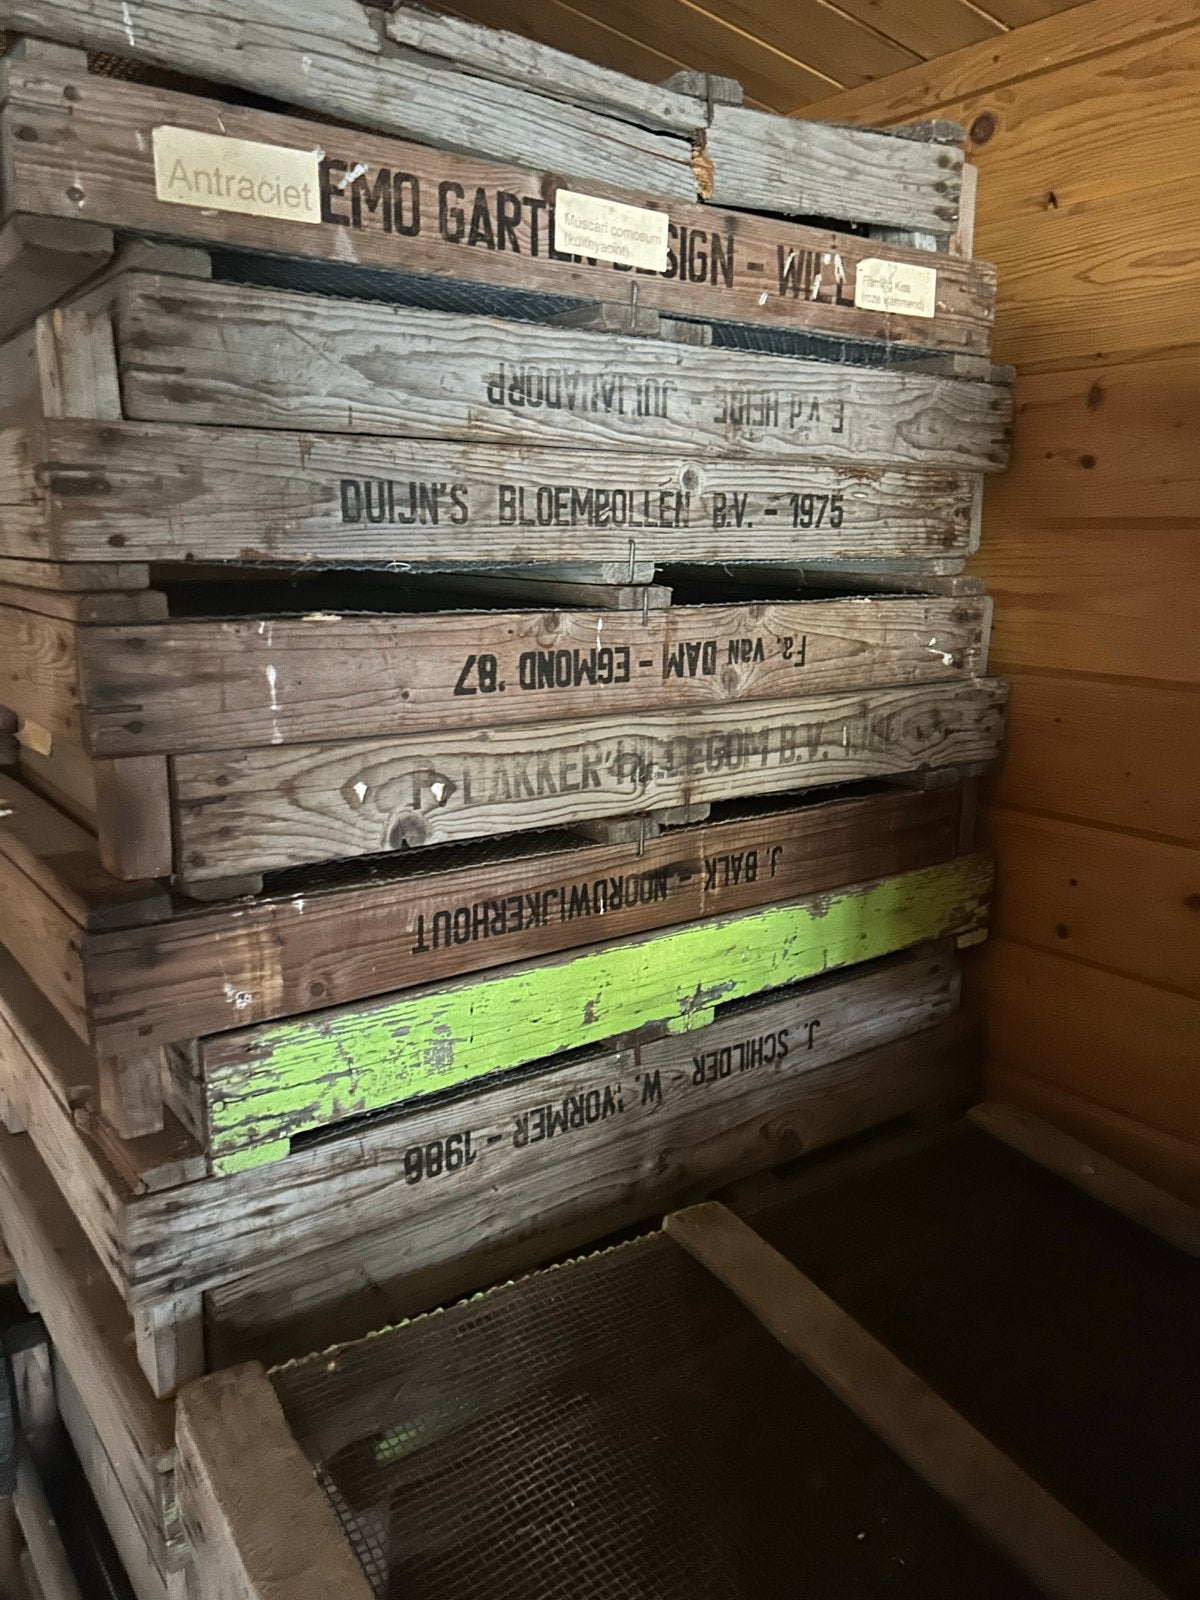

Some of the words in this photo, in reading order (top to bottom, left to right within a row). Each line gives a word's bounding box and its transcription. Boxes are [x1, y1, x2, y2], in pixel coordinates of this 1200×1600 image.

[168, 158, 312, 212] Antraciet
[438, 181, 597, 267] GART
[613, 223, 735, 288] SIGN
[564, 213, 608, 234] Muscari
[610, 226, 662, 246] comosum
[340, 479, 469, 525] DUIJN'S
[499, 484, 691, 528] BLOEMBOLLEN
[712, 492, 753, 528] B.V.
[764, 508, 778, 516] -
[789, 493, 845, 529] 1975
[519, 645, 631, 690] EGMOND
[638, 659, 653, 668] -
[662, 640, 717, 679] DAM
[777, 635, 807, 668] Fa.
[453, 654, 506, 696] '87
[703, 850, 757, 892] BALK
[766, 845, 784, 879] J.
[411, 873, 669, 955] NOORDWIJKERHOUT
[803, 1019, 821, 1050] J.
[691, 1028, 790, 1087] SCHILDER
[634, 1068, 663, 1107] W.
[403, 1129, 478, 1186] 1986
